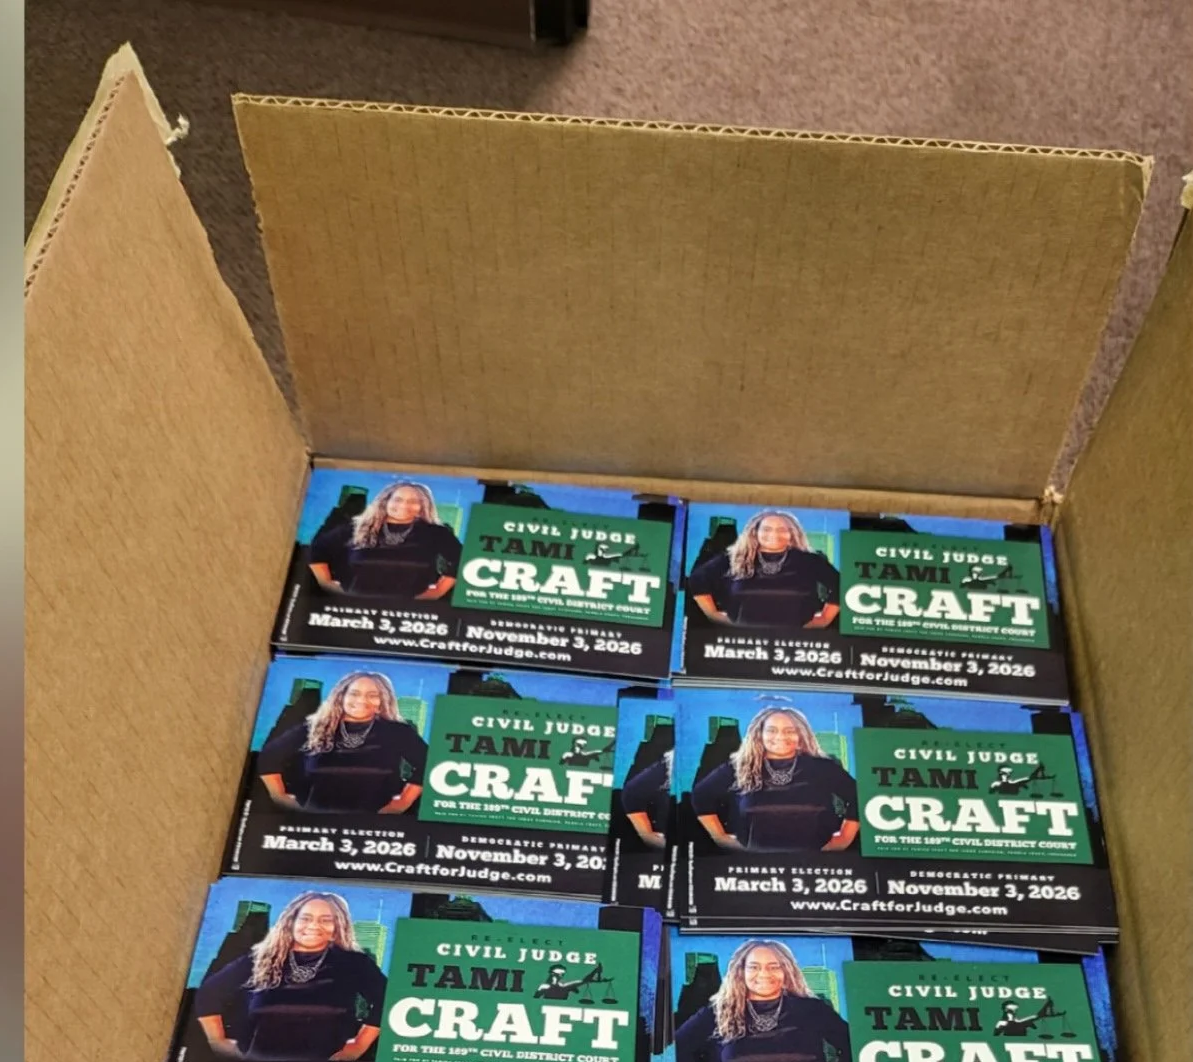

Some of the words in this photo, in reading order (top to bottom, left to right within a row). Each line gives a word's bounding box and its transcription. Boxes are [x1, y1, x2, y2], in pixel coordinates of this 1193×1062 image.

[503, 522, 561, 536] CIVIL
[571, 528, 635, 544] JUDGE
[480, 535, 574, 560] TAMI
[876, 547, 933, 560] CIVIL
[943, 552, 1007, 566] JUDGE
[462, 558, 660, 603] CRAFT
[855, 562, 951, 584] TAMI
[844, 584, 1040, 626] CRAFT
[308, 613, 373, 630] March
[379, 618, 395, 634] 3,
[399, 620, 448, 635] 2026
[374, 636, 571, 661] www.CraftforJudge.com
[466, 626, 569, 649] November
[573, 636, 589, 651] 3,
[594, 639, 642, 654] 2026
[705, 645, 768, 660] March
[774, 648, 790, 664] 3,
[794, 650, 841, 664] 2026
[860, 653, 962, 672] November
[967, 660, 983, 676] 3,
[988, 662, 1035, 677] 2026
[771, 667, 967, 686] www.CraftforJudge.com
[472, 716, 534, 731] CIVIL
[545, 721, 615, 738] JUDGE
[445, 734, 551, 760] TAMI
[894, 749, 956, 761] CIVIL
[968, 751, 1038, 764] JUDGE
[872, 767, 979, 790] TAMI
[865, 796, 1078, 836] CRAFT
[280, 826, 337, 834] PRIMARY
[343, 829, 404, 838] ELECTION
[262, 835, 334, 852] March
[339, 839, 358, 856] 3,
[363, 840, 415, 856] 2026
[462, 836, 543, 848] DEMOCRATIC
[550, 843, 605, 852] PRIMARY
[436, 844, 548, 866] November
[553, 853, 571, 870] 3,
[576, 855, 606, 870] 20
[335, 862, 551, 882] www.CraftforJudge.com
[910, 871, 991, 879] DEMOCRATIC
[715, 877, 786, 892] March
[792, 878, 809, 894] 3,
[815, 878, 867, 894] 2026
[887, 880, 999, 897] November
[1005, 884, 1024, 901] 3,
[1029, 885, 1081, 900] 2026
[791, 899, 1007, 916] www.CraftforJudge.com
[437, 944, 506, 958] CIVIL
[518, 948, 597, 964] JUDGE
[407, 963, 525, 992] TAMI
[889, 986, 957, 997] CIVIL
[969, 986, 1046, 1000] JUDGE
[387, 998, 629, 1049] CRAFT
[865, 1007, 983, 1031] TAMI
[393, 1044, 417, 1052] FOR
[421, 1046, 445, 1054] THE
[480, 1049, 513, 1058] CIVIL
[516, 1052, 575, 1062] DISTRICT
